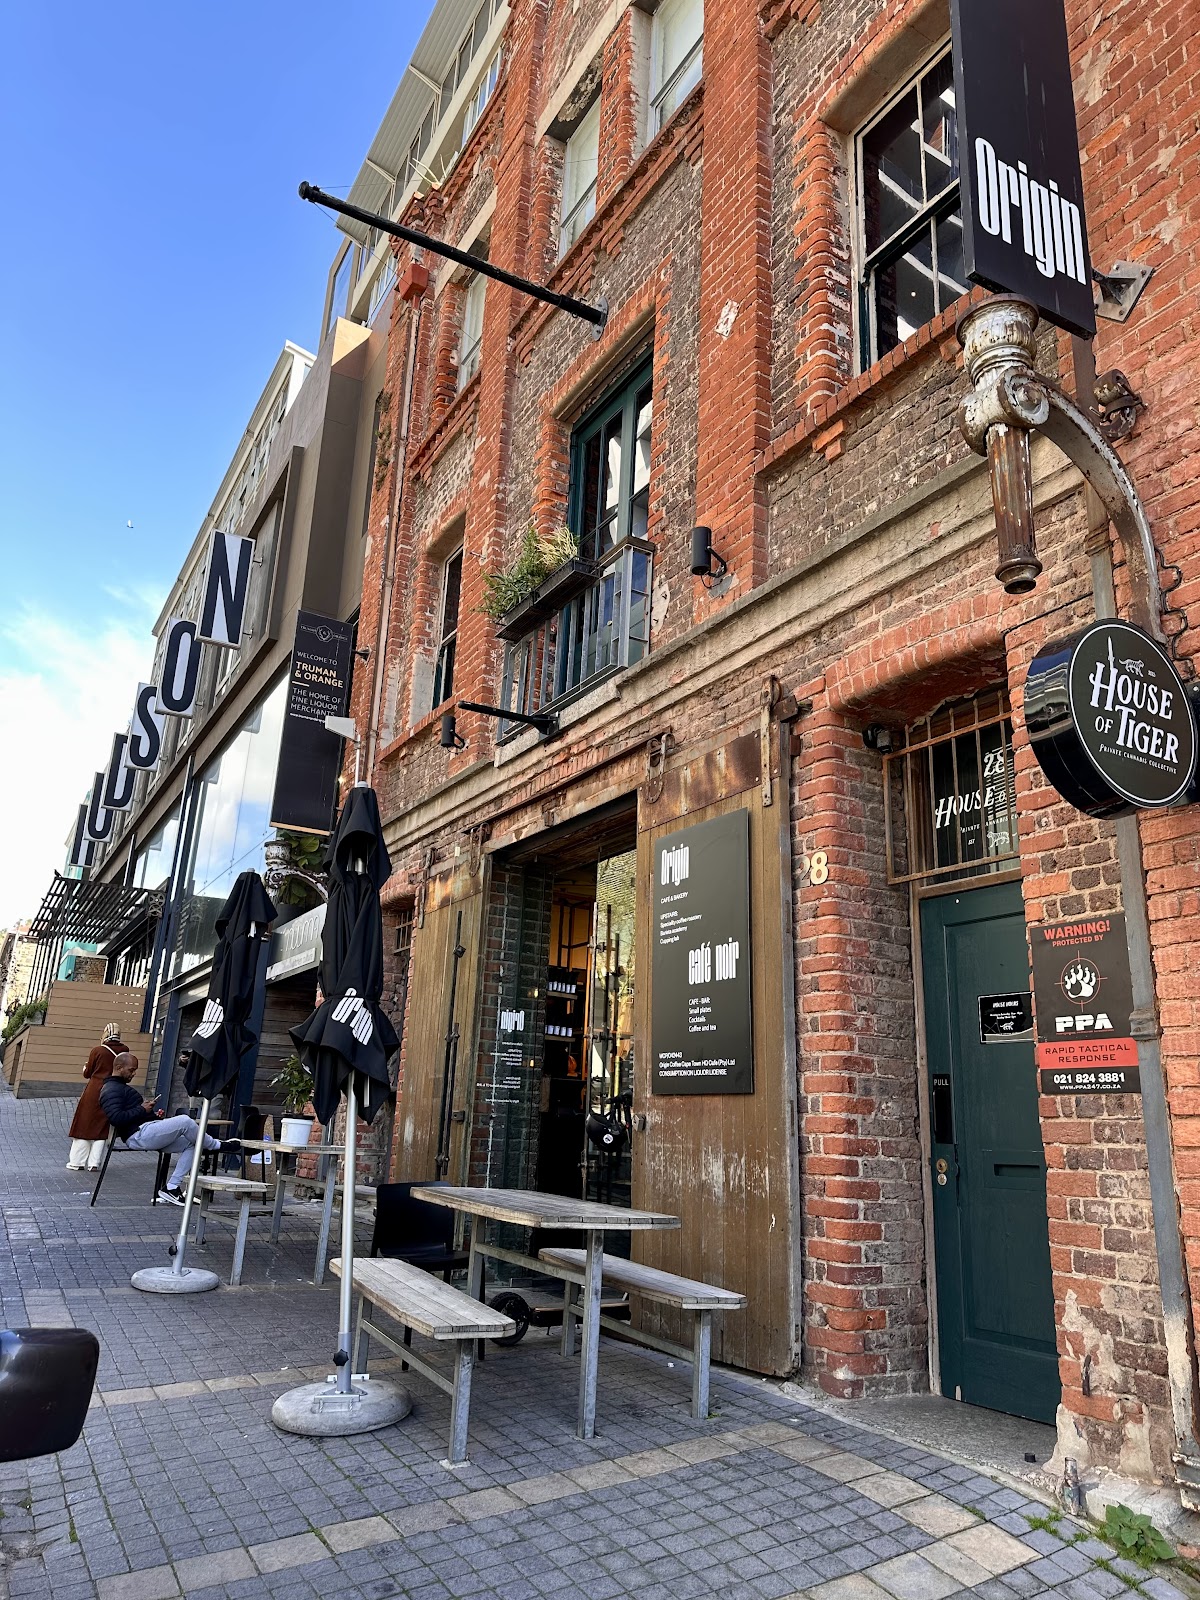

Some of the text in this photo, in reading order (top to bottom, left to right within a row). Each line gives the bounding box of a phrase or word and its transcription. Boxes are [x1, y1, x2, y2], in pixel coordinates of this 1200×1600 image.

[975, 137, 1086, 286] Origin
[296, 651, 327, 664] WELCOME
[294, 669, 344, 688] & ORANGE
[296, 661, 337, 678] TRUMAN
[292, 687, 342, 704] THE HOME OF
[1088, 657, 1174, 720] HOUSE
[290, 703, 335, 717] MERCHANTS
[291, 695, 338, 711] FINE LIQUOR
[1095, 704, 1179, 764] OF TIGER
[1098, 743, 1177, 775] PRIVATE CANNABIS COLLECTIVE
[935, 786, 995, 829] HOUSE
[661, 843, 690, 887] Origin
[794, 851, 829, 887] 28
[674, 891, 689, 901] BAKERY
[1044, 919, 1111, 941] WARNING!
[1052, 933, 1104, 947] PROTECTED BY
[688, 937, 739, 985] café noir
[689, 1024, 701, 1032] Coffee
[1055, 1013, 1114, 1033] PPA
[1045, 1043, 1131, 1055] RAPID TACTICAL
[1058, 1054, 1116, 1063] RESPONSE
[1053, 1072, 1125, 1084] 021 824 3881
